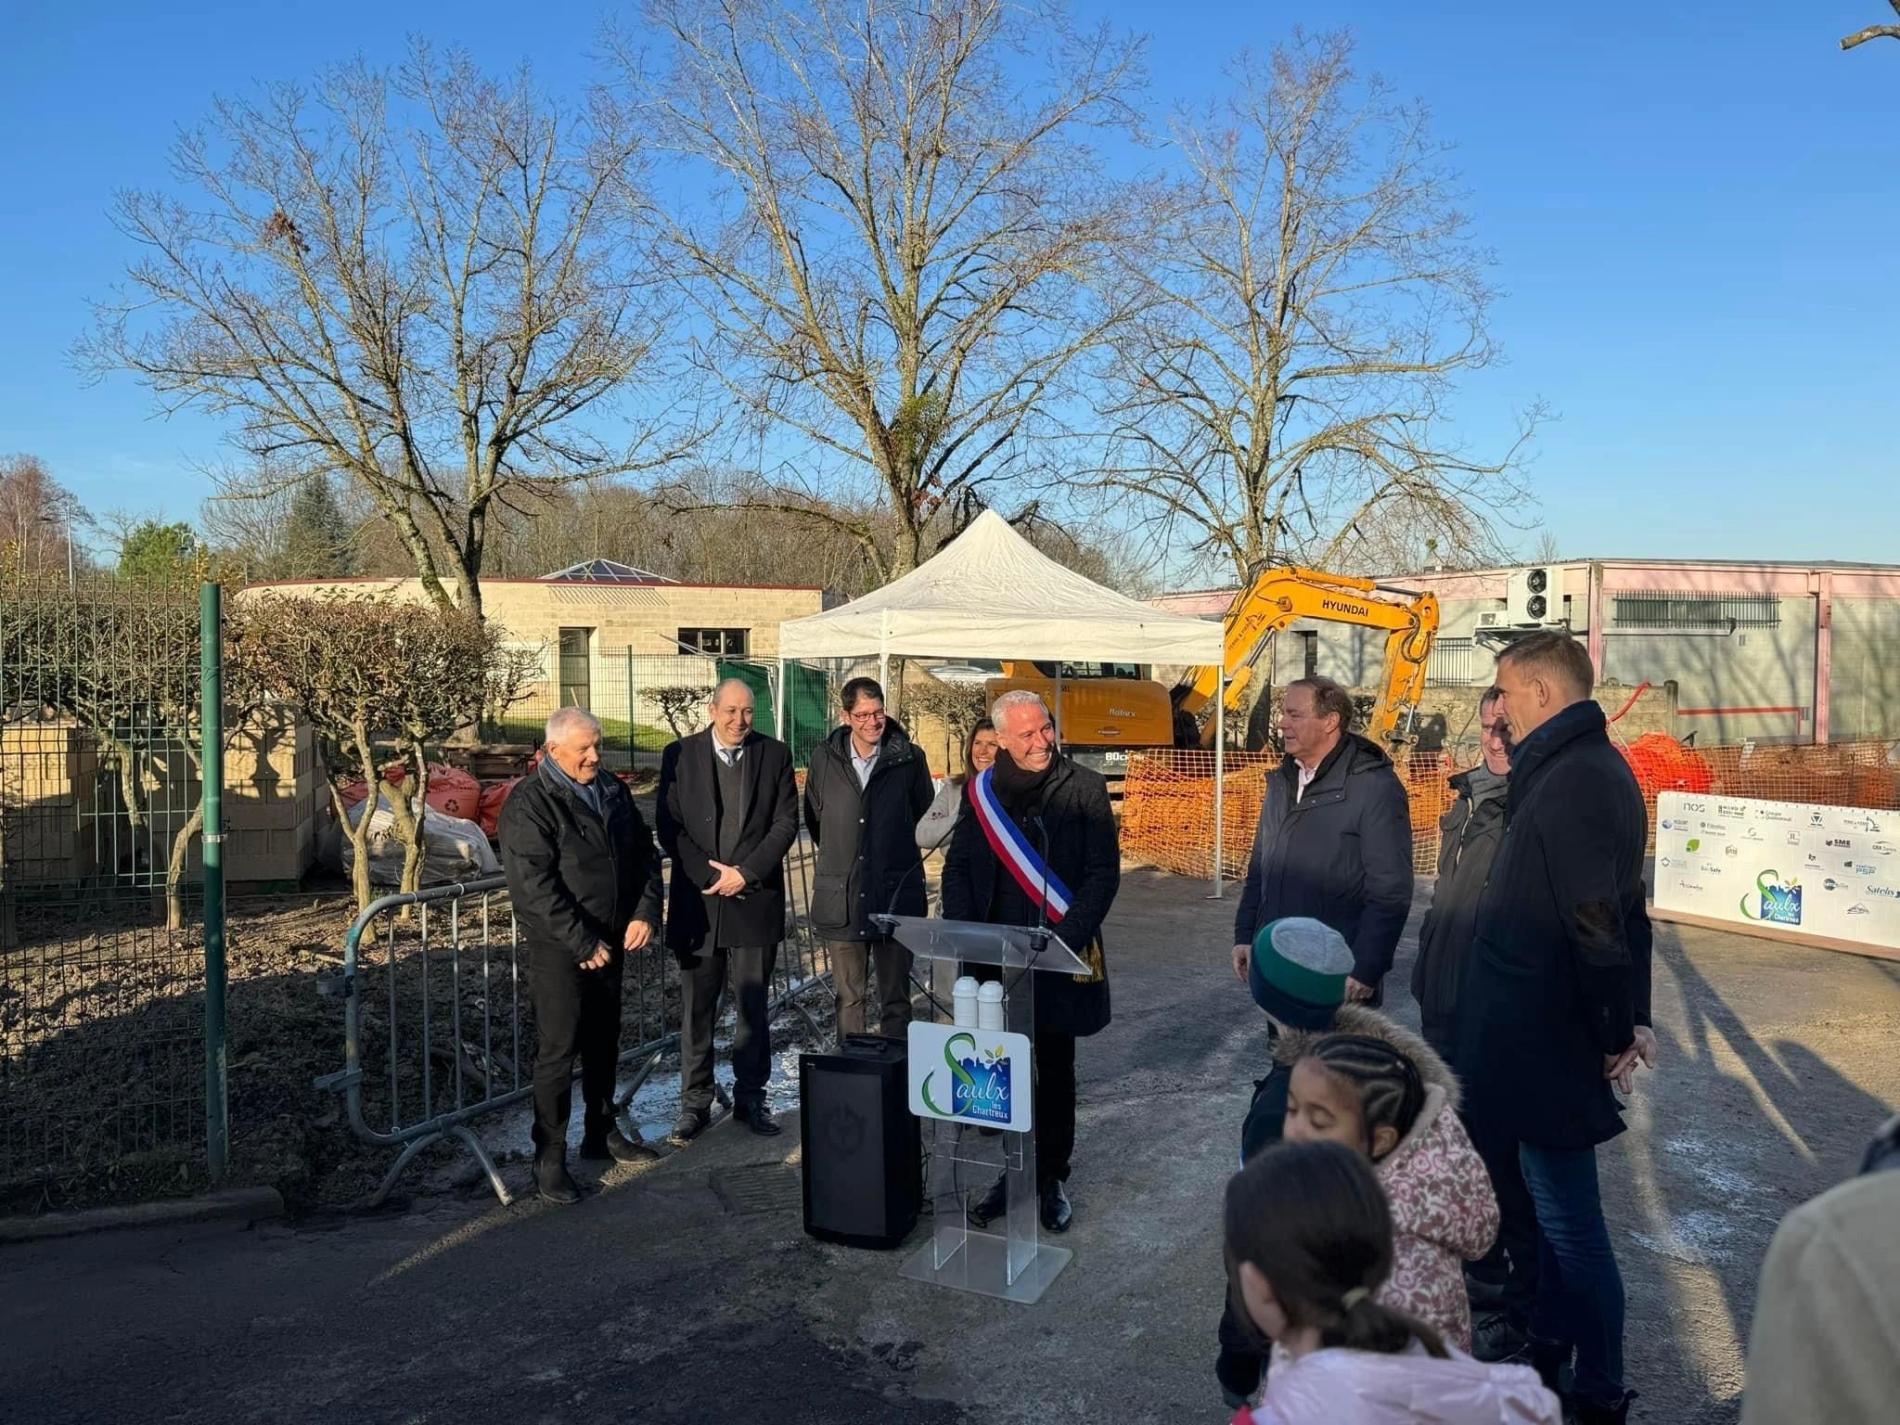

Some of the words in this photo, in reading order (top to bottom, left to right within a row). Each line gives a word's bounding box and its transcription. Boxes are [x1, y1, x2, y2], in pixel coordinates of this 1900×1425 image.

[1322, 599, 1369, 617] HYUNDAI
[922, 1032, 1009, 1117] Saulx
[972, 1105, 1009, 1119] Chartreux
[991, 1101, 1002, 1110] les
